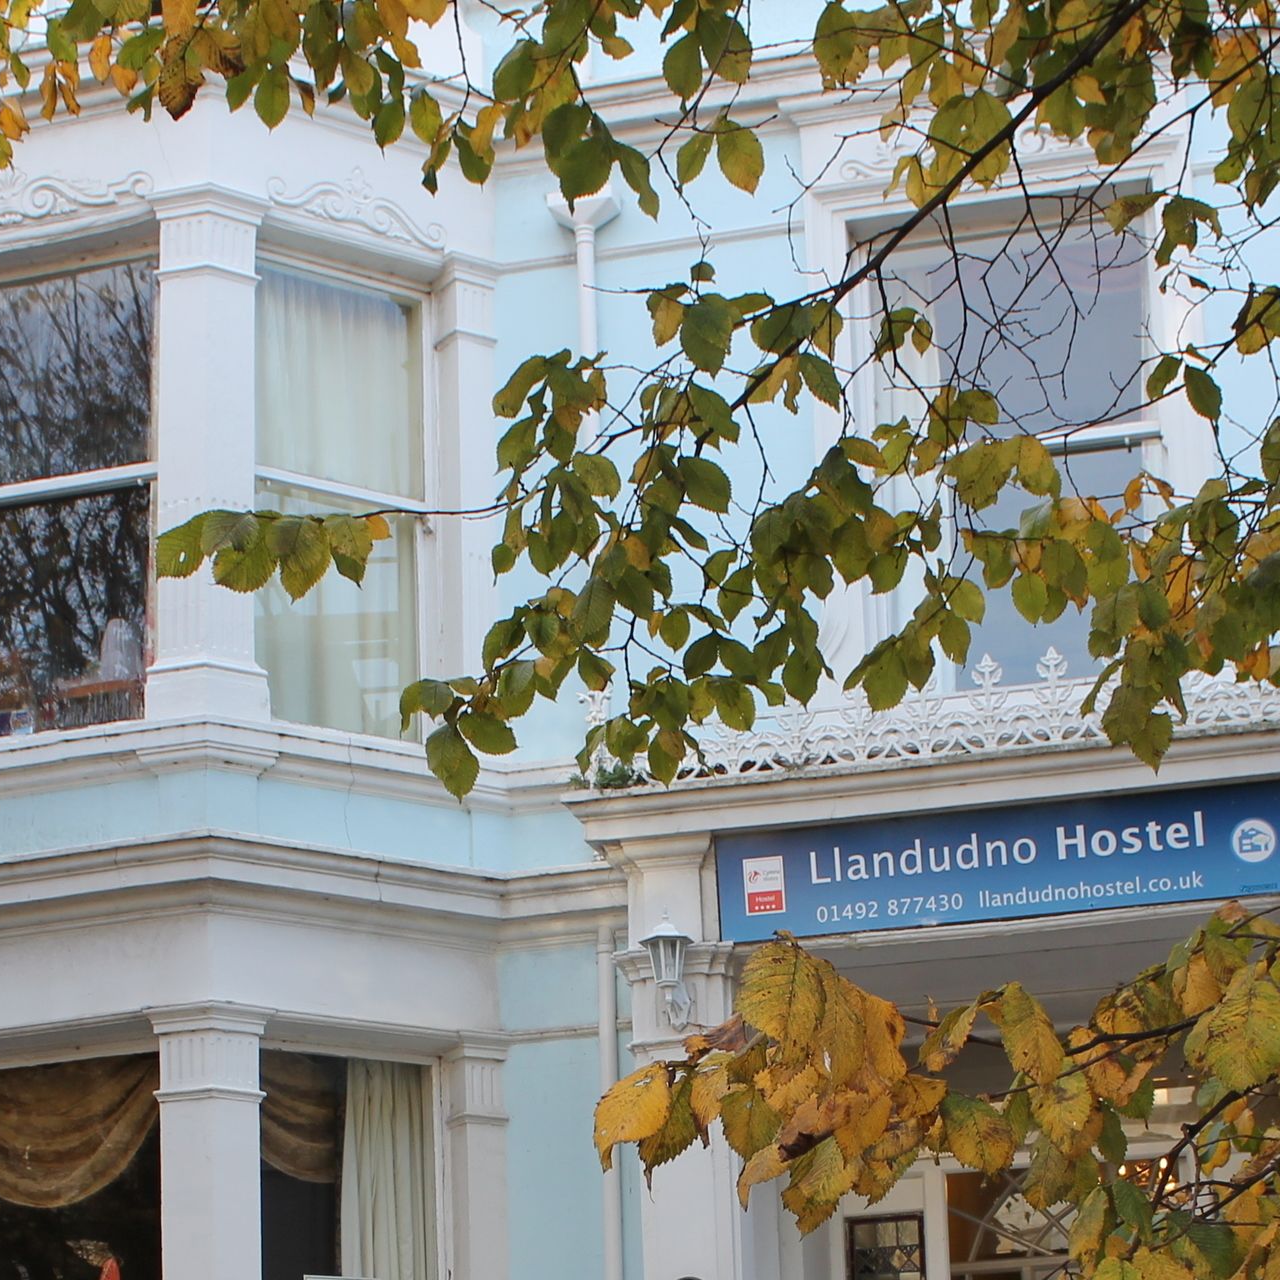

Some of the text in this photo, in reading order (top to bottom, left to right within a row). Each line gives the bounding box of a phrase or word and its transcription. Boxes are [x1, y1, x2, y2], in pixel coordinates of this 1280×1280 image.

[809, 810, 1205, 884] Llandudno Hostel
[816, 871, 1204, 923] 01492 877430 llandudnohostel.co.uk
